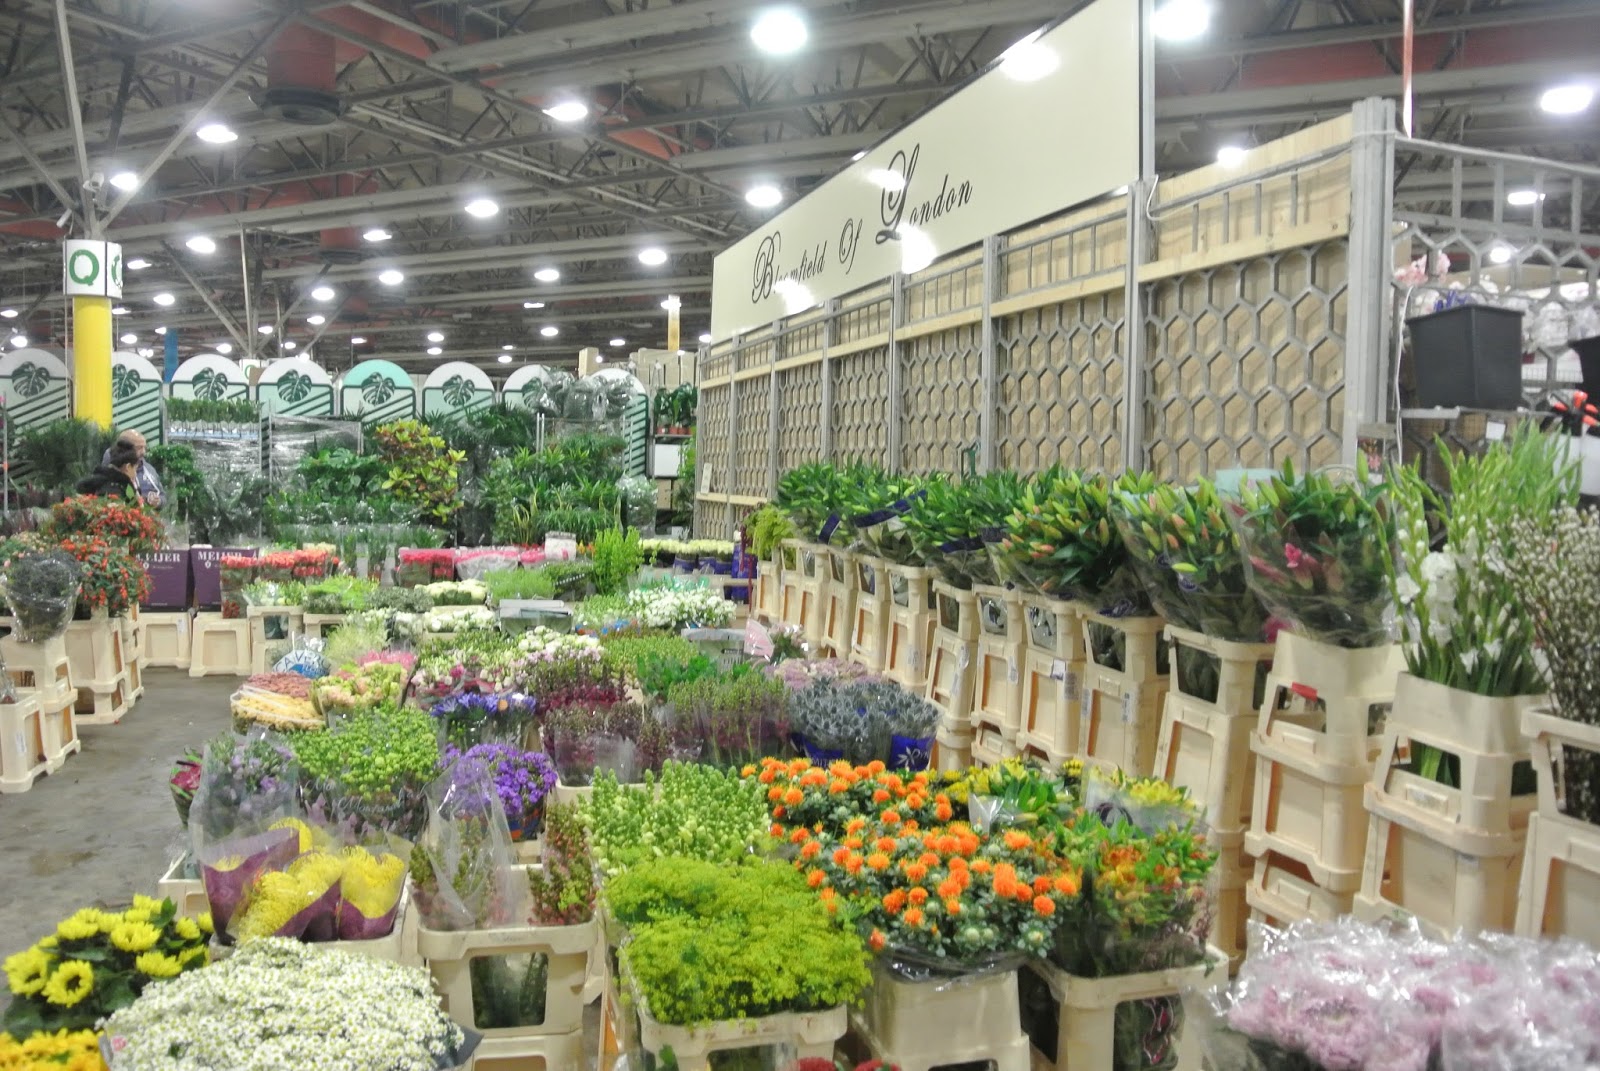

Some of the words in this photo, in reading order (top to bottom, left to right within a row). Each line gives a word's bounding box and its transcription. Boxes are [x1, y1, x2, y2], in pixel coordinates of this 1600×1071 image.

[839, 218, 863, 275] Of
[875, 142, 973, 246] London
[69, 249, 100, 286] Q
